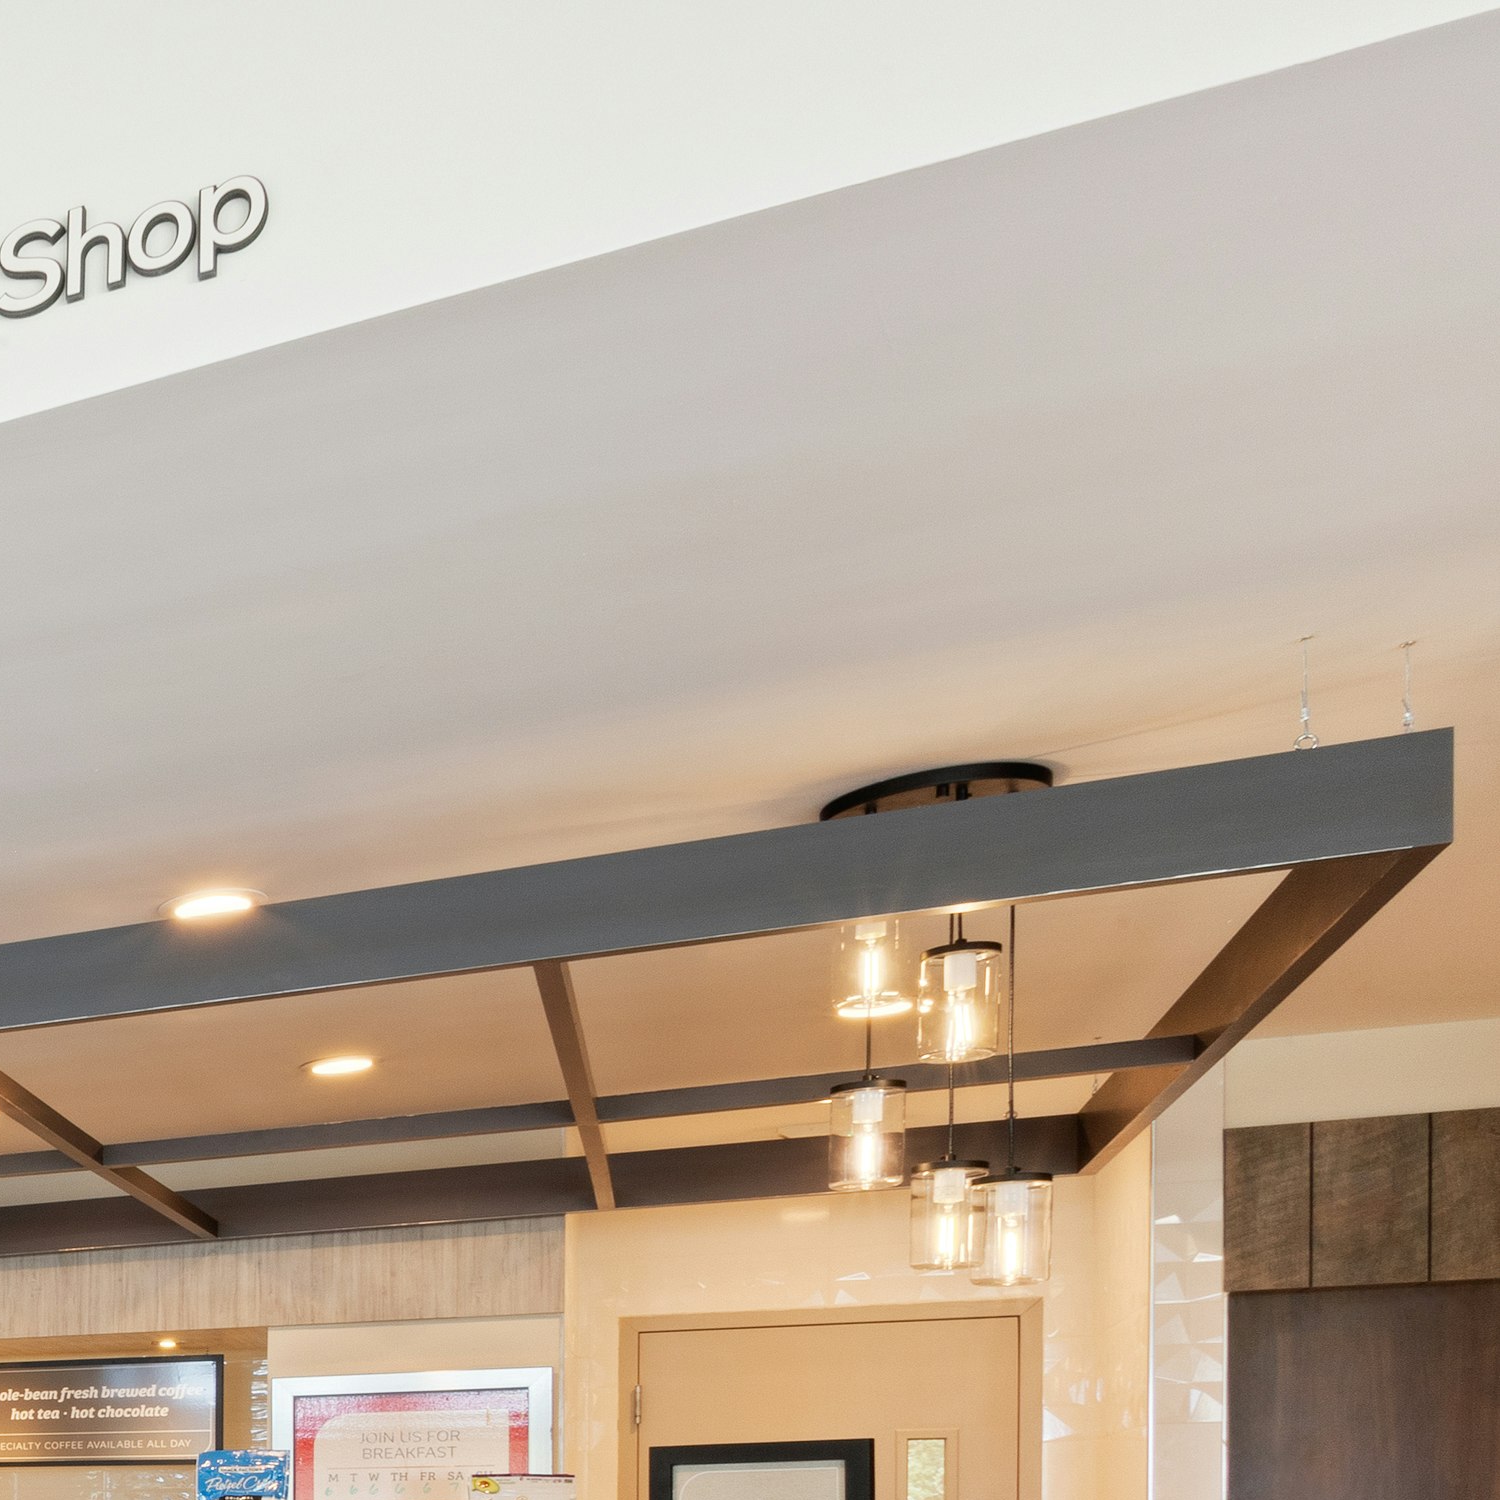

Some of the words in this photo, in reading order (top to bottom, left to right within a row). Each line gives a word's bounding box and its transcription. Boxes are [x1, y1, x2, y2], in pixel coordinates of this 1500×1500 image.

[58, 1386, 98, 1403] fresh
[101, 1384, 156, 1399] brewed
[158, 1383, 203, 1399] coffee
[10, 1408, 35, 1421] hot
[37, 1408, 60, 1420] tea
[70, 1406, 95, 1419] hot
[97, 1404, 169, 1419] chocolate
[44, 1440, 84, 1451] COFFEE
[86, 1439, 143, 1450] AVAILABLE
[146, 1439, 167, 1449] ALL
[170, 1438, 192, 1449] DAY
[360, 1431, 395, 1445] JOIN
[400, 1431, 422, 1443] US
[427, 1430, 461, 1443] FOR
[362, 1446, 457, 1460] BREAKFAST
[328, 1473, 339, 1483] M
[350, 1473, 358, 1482] T
[369, 1473, 380, 1482] W
[391, 1472, 408, 1482] TH
[420, 1472, 436, 1481] FR
[447, 1471, 464, 1481] SA
